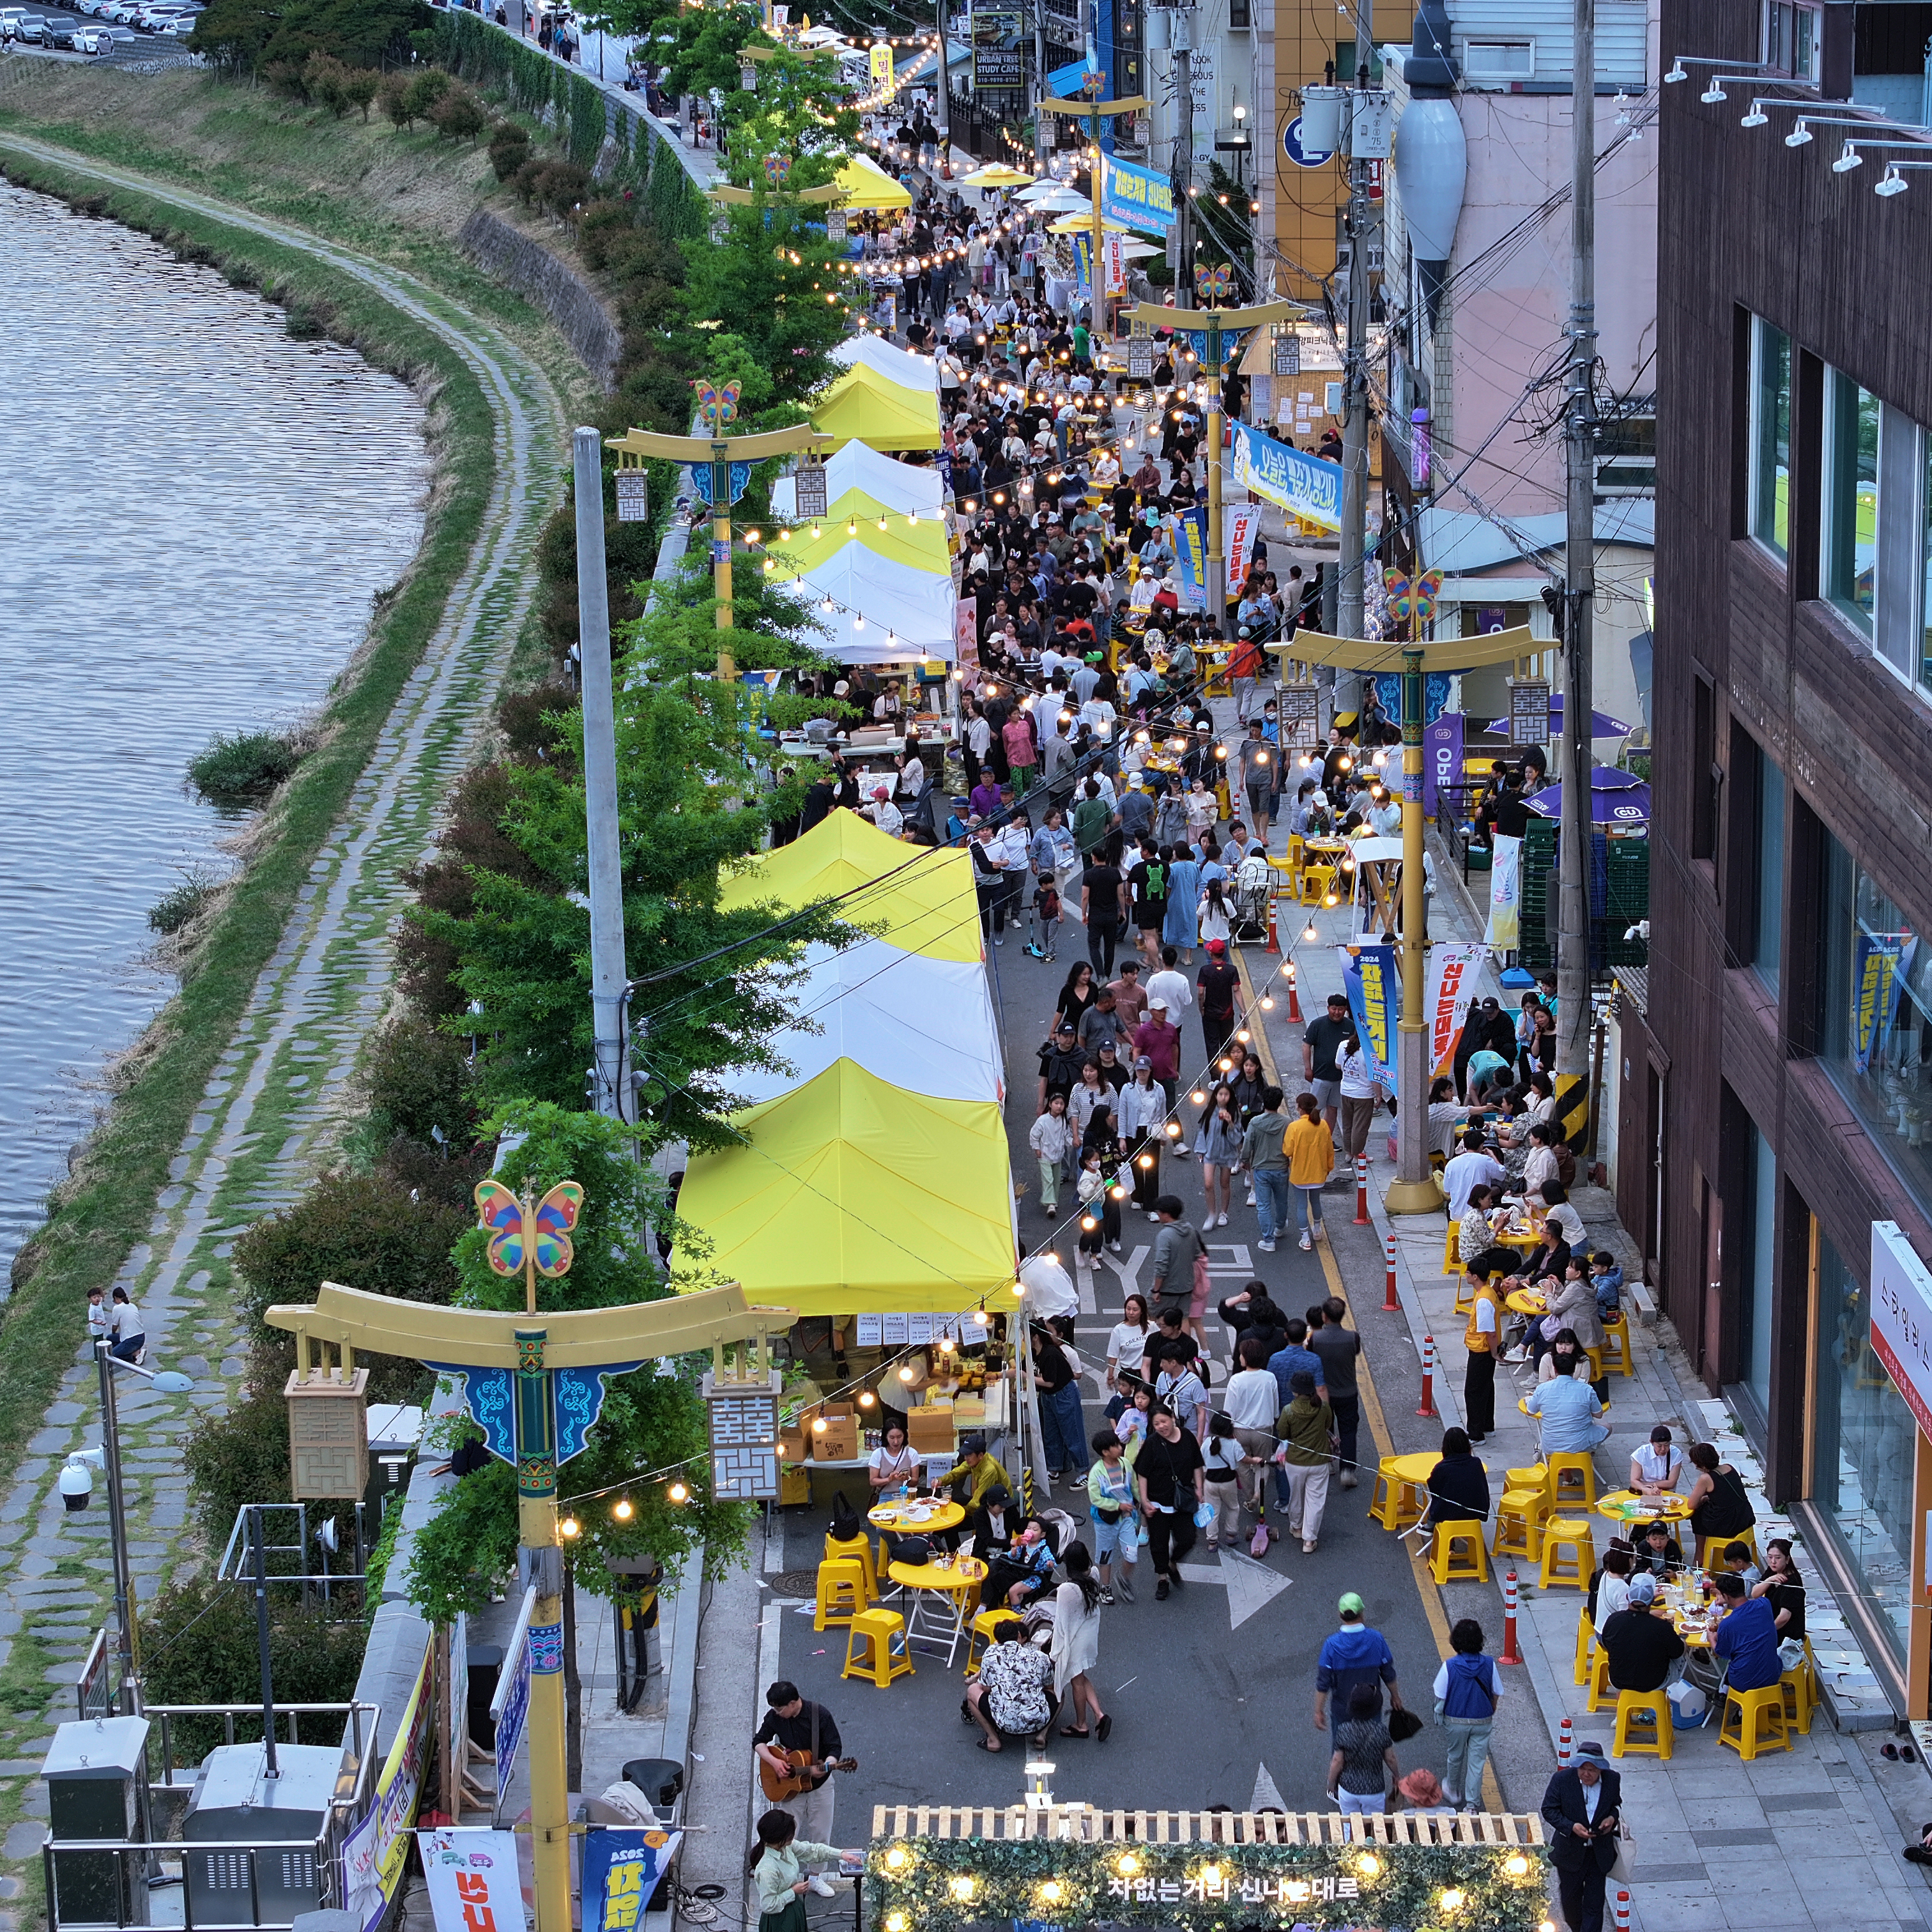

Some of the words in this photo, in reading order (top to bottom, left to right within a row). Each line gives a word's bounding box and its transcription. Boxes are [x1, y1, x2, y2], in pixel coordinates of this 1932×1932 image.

[977, 55, 1001, 63] URBAN
[1003, 55, 1018, 63] TREE
[1192, 56, 1212, 64] LOOK
[1172, 72, 1213, 80] GGEOUS
[1192, 88, 1206, 96] THE
[1372, 137, 1381, 145] 75
[1112, 241, 1120, 283] 신나는대로
[1260, 444, 1287, 487] 오늘은
[1286, 455, 1312, 498] 맥주가
[1311, 466, 1337, 509] 땡긴다
[1229, 519, 1248, 582] 신나는대로
[1360, 963, 1387, 1062] 차없는거리
[1434, 963, 1464, 1057] 신나는대로
[1125, 1336, 1147, 1346] CREATIV
[1924, 1412, 1932, 1434] 귀금
[1108, 1876, 1229, 1902] 차없는거리
